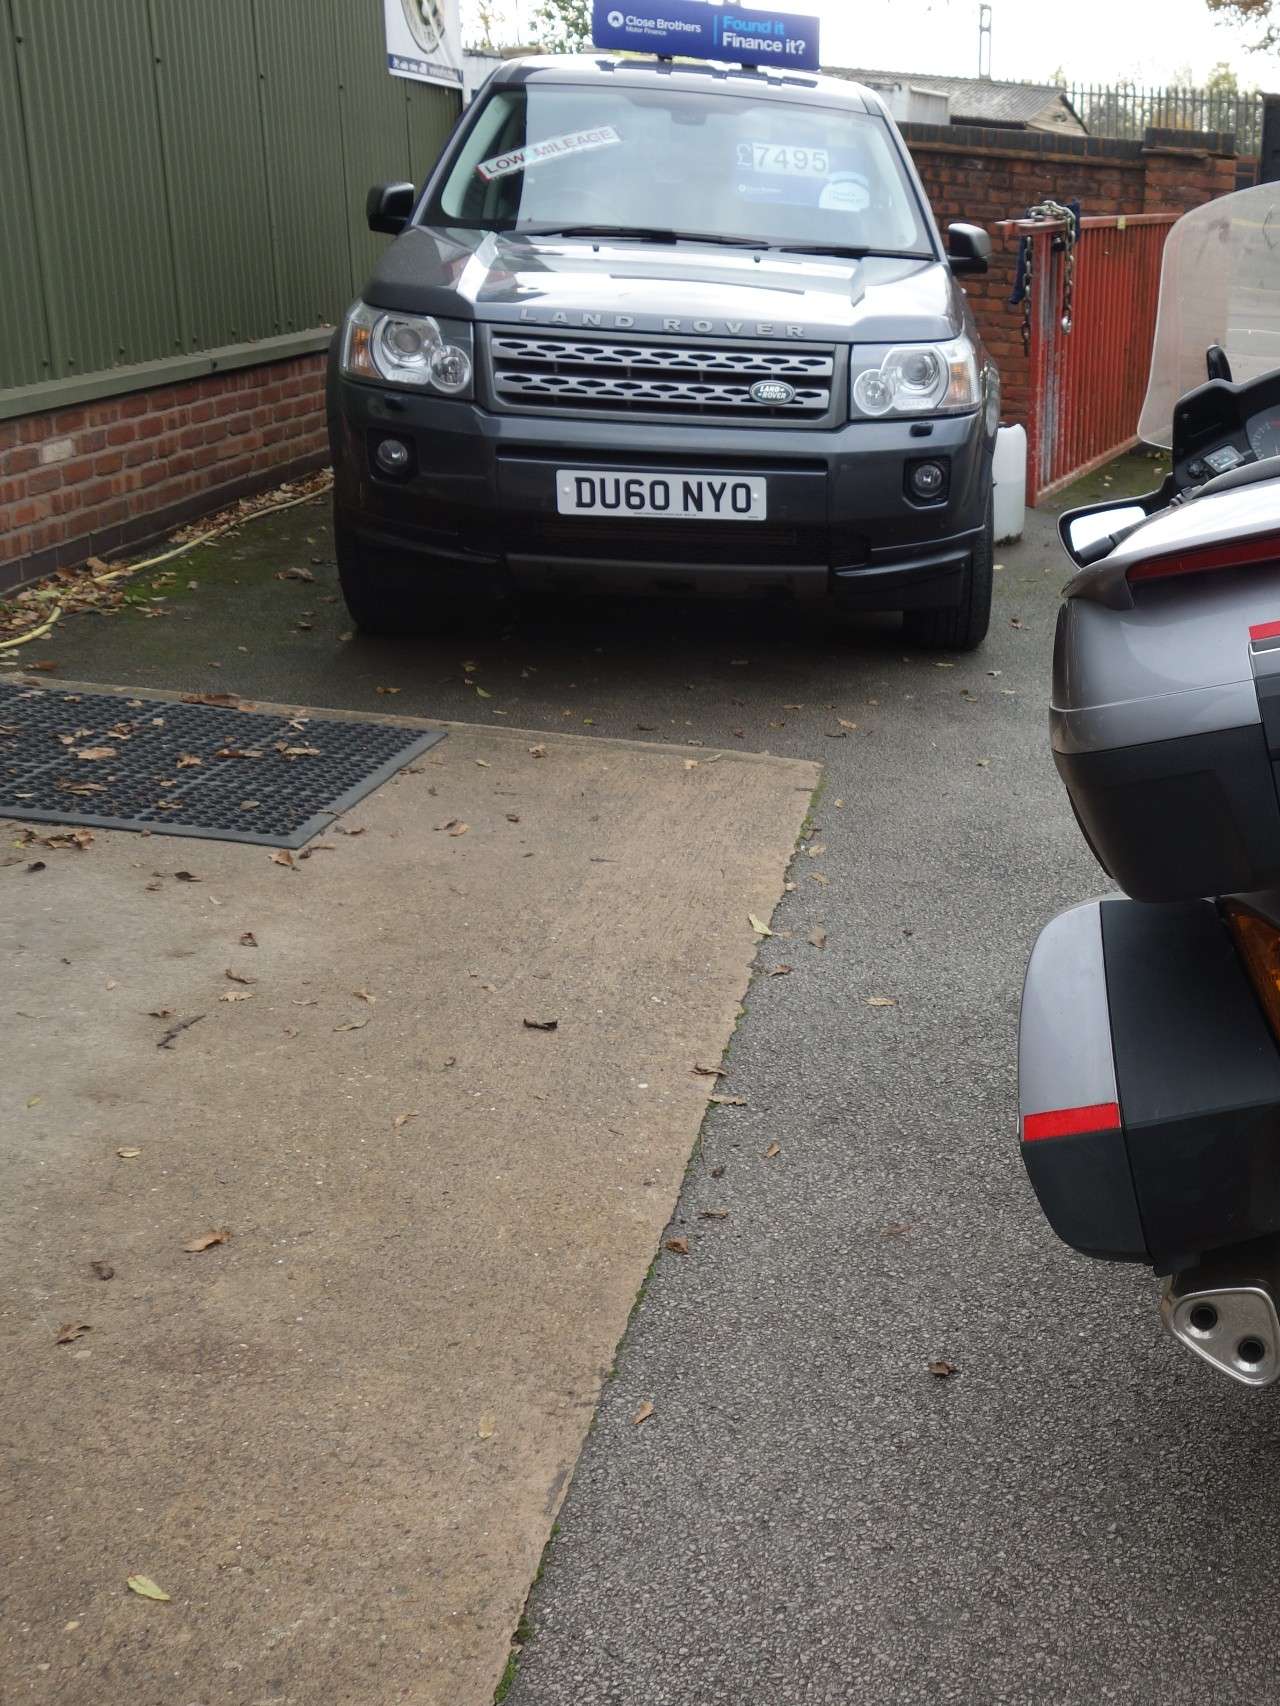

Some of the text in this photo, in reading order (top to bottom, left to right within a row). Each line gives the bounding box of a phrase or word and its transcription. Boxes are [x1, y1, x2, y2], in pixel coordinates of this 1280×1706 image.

[625, 15, 702, 33] Close Brothers
[625, 26, 667, 36] Motor Finance
[722, 15, 785, 36] Found it
[722, 32, 806, 55] Finance it?
[484, 129, 614, 174] LOW MILEAGE
[519, 307, 806, 338] LAND ROVER
[574, 476, 670, 511] DU60
